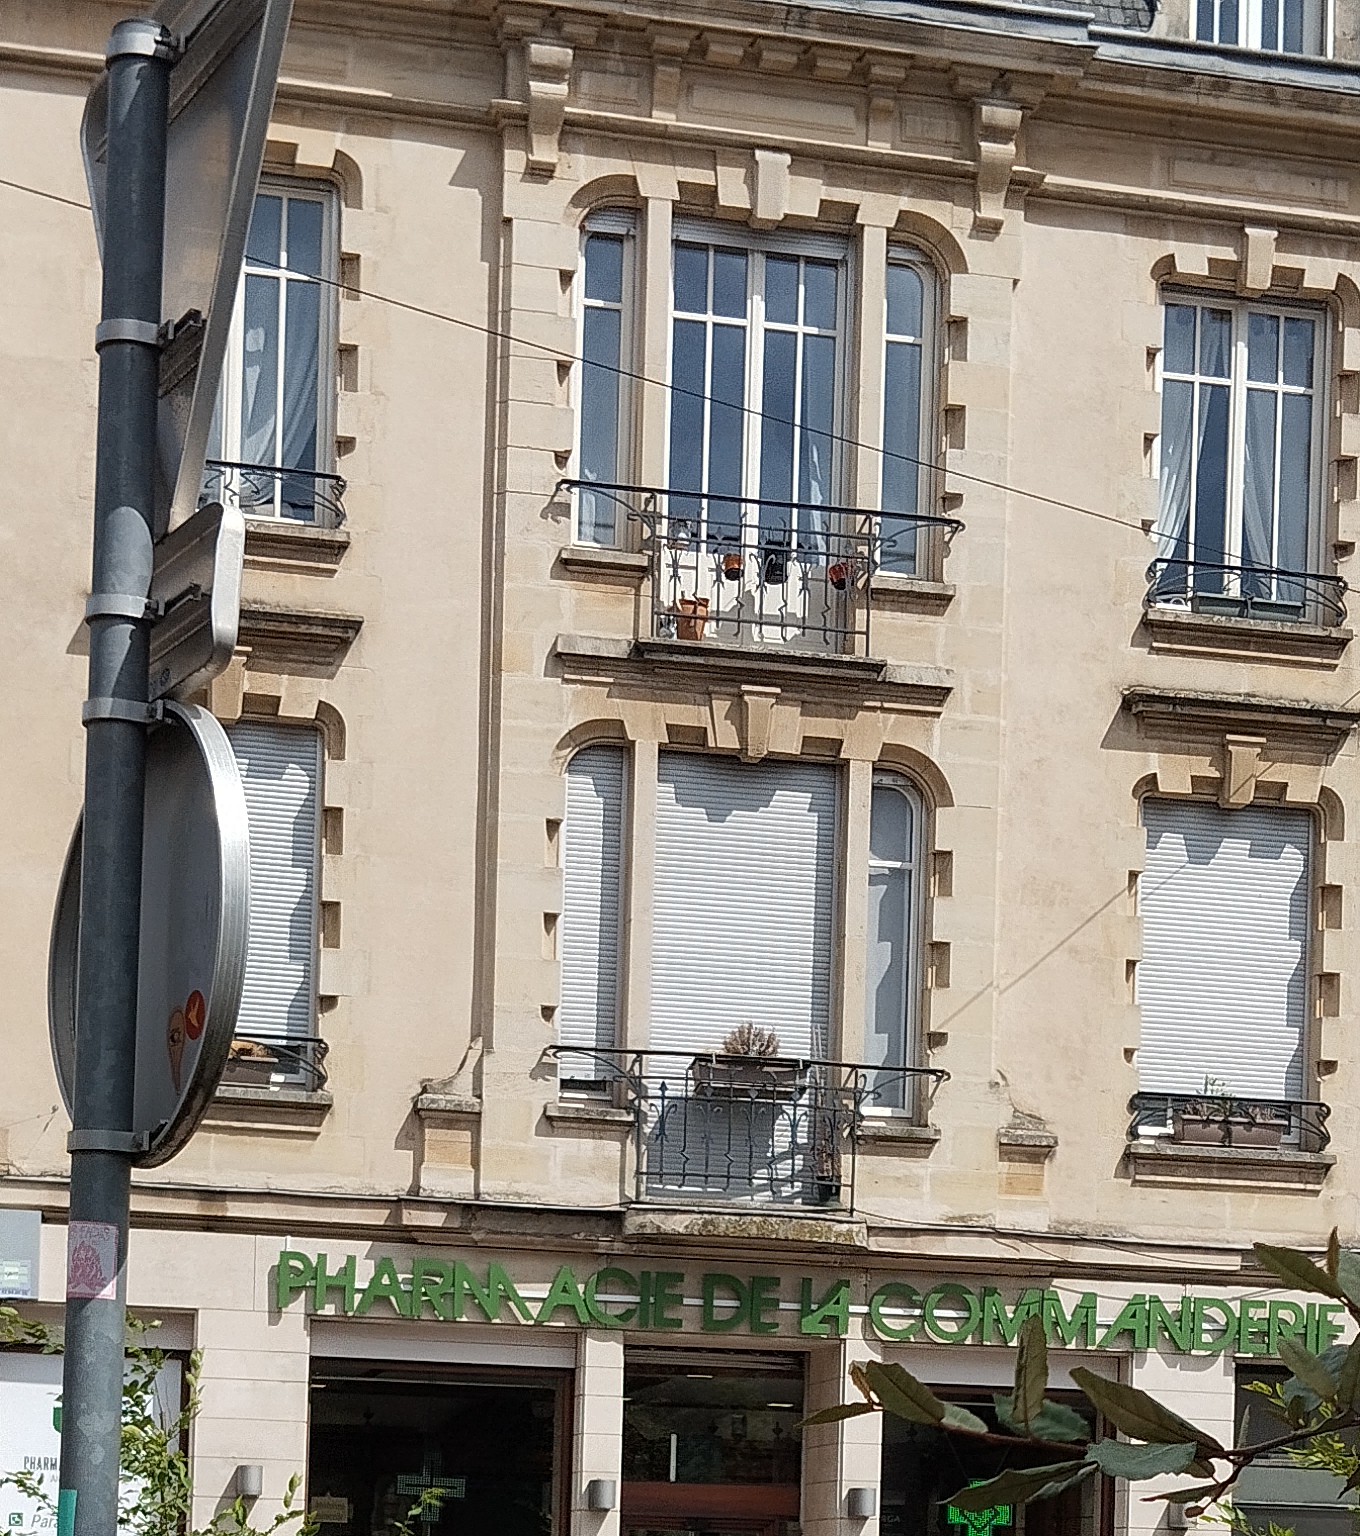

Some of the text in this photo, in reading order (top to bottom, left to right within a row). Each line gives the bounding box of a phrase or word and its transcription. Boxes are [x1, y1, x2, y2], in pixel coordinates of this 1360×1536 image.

[277, 1250, 1346, 1357] PHARMACIE DE LA COMMANDERIE
[23, 1456, 58, 1471] PHARM
